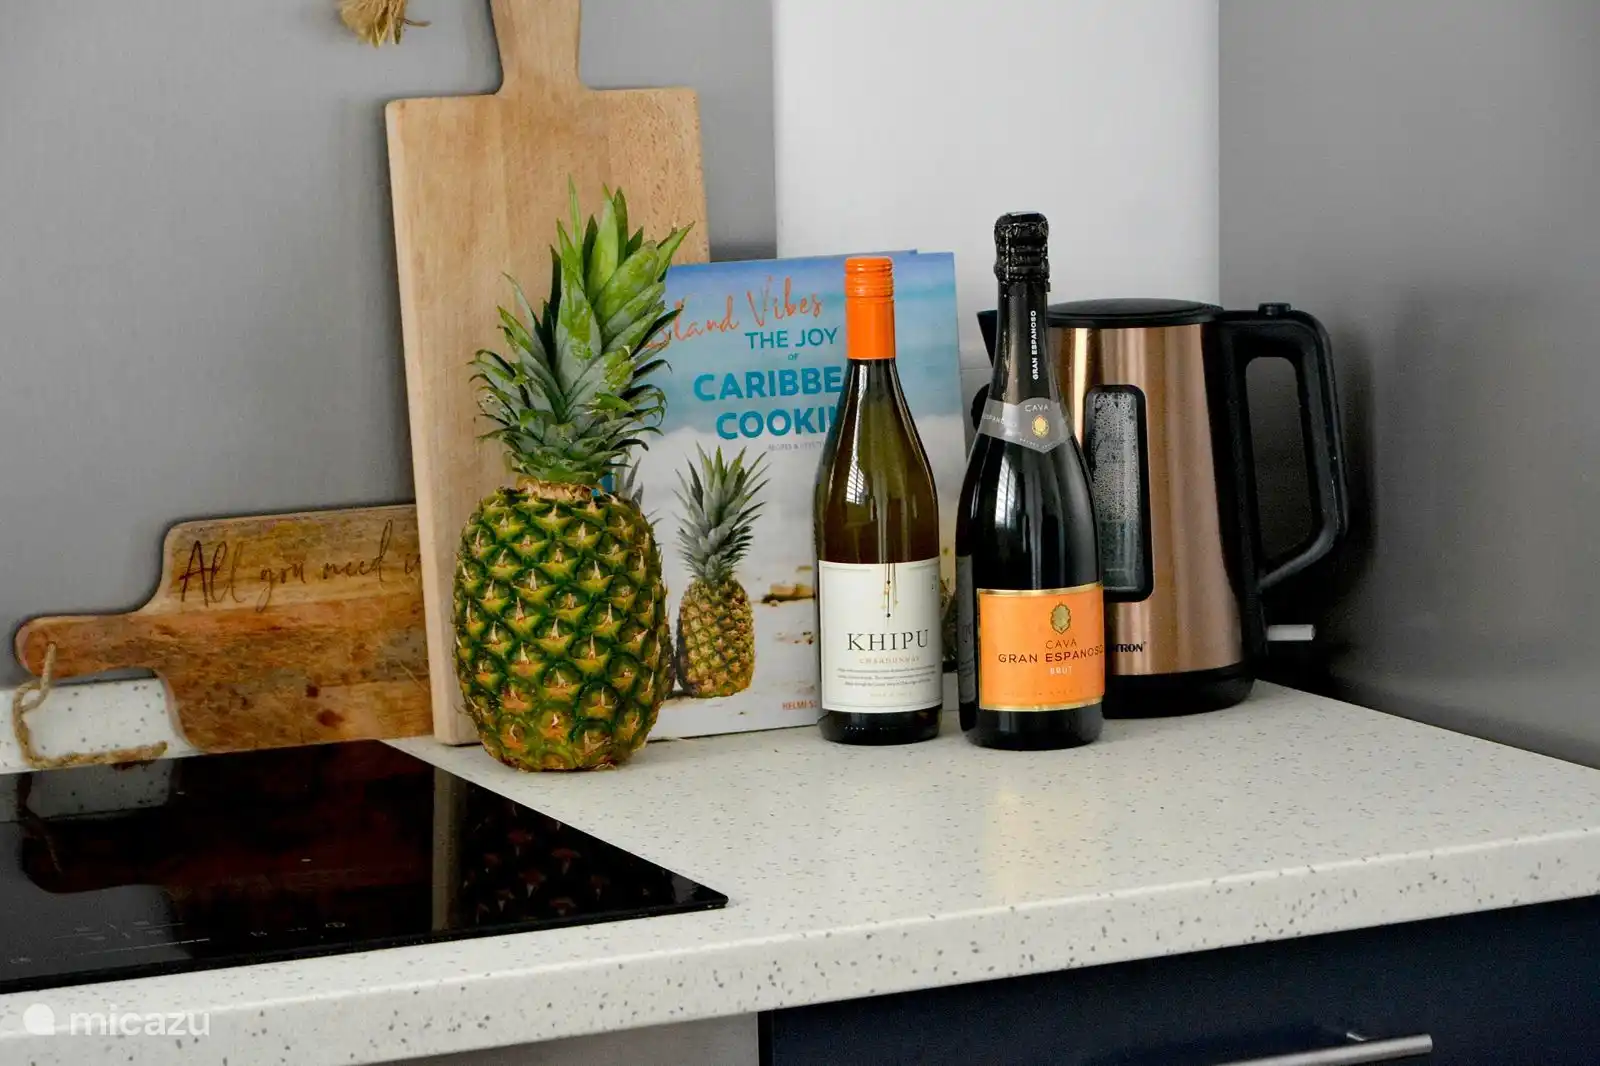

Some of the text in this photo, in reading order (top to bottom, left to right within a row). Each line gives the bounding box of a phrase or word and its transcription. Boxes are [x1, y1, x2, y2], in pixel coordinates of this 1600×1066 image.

[645, 276, 823, 349] sland Vibes
[744, 326, 840, 350] THE JOY
[1030, 310, 1038, 355] ESPANOSO
[694, 366, 845, 402] CARIBBE
[1024, 403, 1049, 412] CAVA
[178, 540, 248, 608] All
[321, 519, 393, 584] need
[847, 629, 929, 652] KHIPU
[1045, 638, 1077, 650] CAVA
[1115, 643, 1143, 653] TRON
[998, 653, 1038, 664] GRAN
[1050, 665, 1073, 675] BRUT
